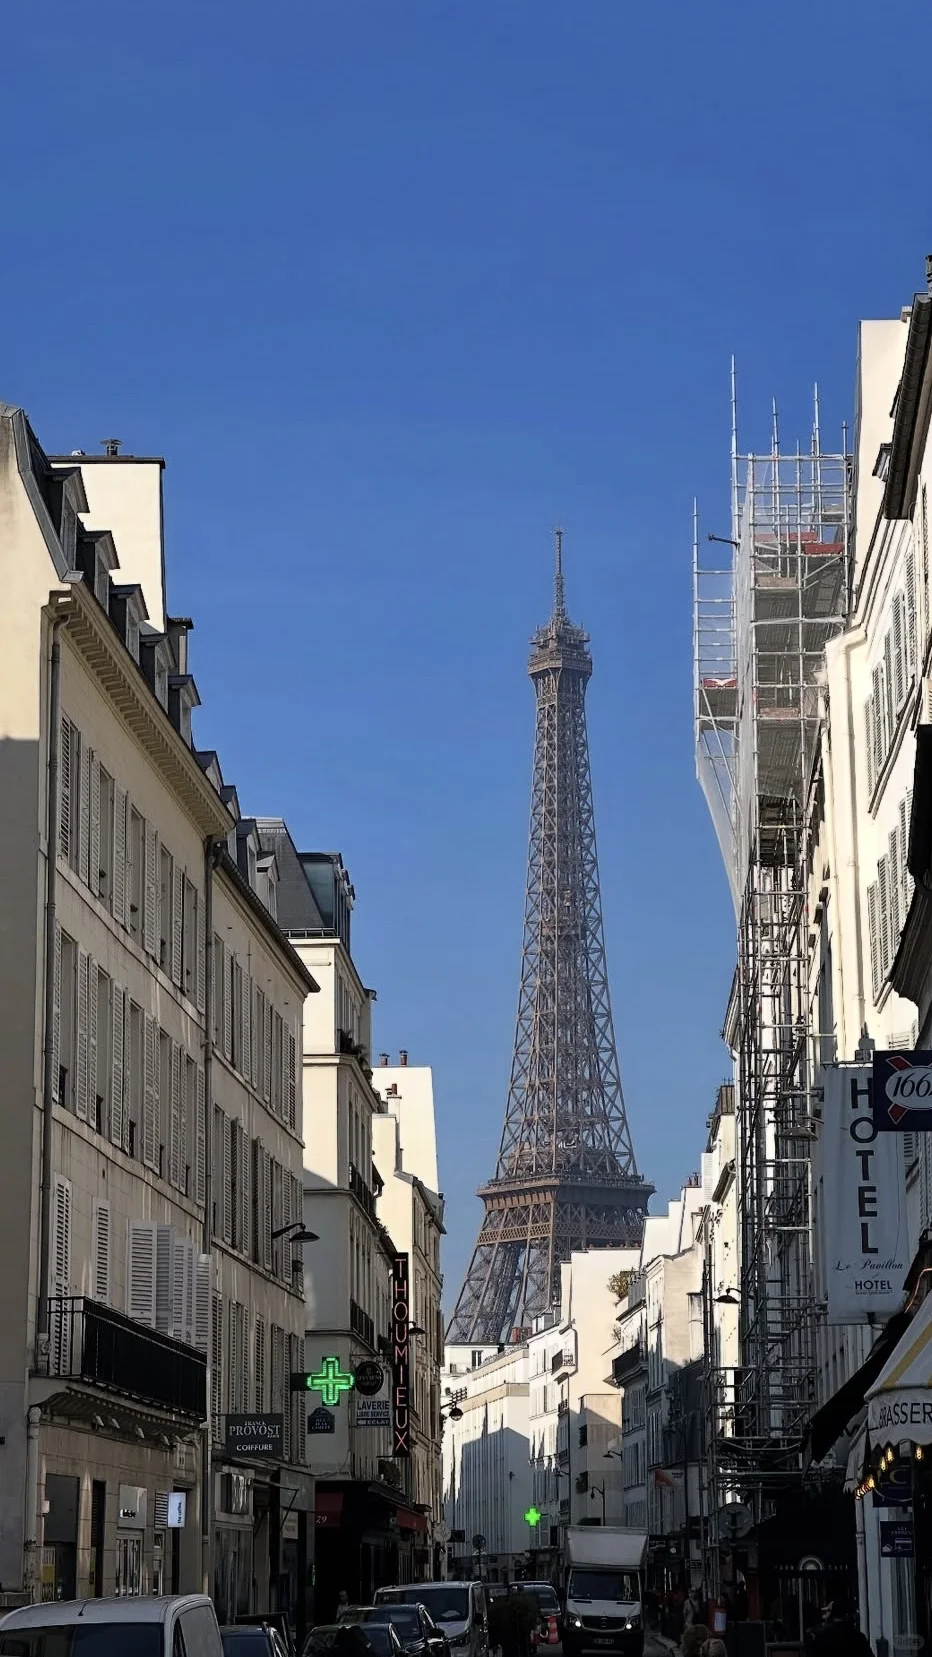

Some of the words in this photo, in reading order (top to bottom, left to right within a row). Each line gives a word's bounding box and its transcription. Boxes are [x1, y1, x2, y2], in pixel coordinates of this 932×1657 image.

[850, 1077, 879, 1254] HOTEL
[855, 1280, 892, 1290] HOTEL
[393, 1258, 409, 1452] THOUMIEUX
[356, 1401, 390, 1410] LAVERIE
[229, 1424, 280, 1436] PROVOST
[236, 1444, 273, 1452] COIFFURE
